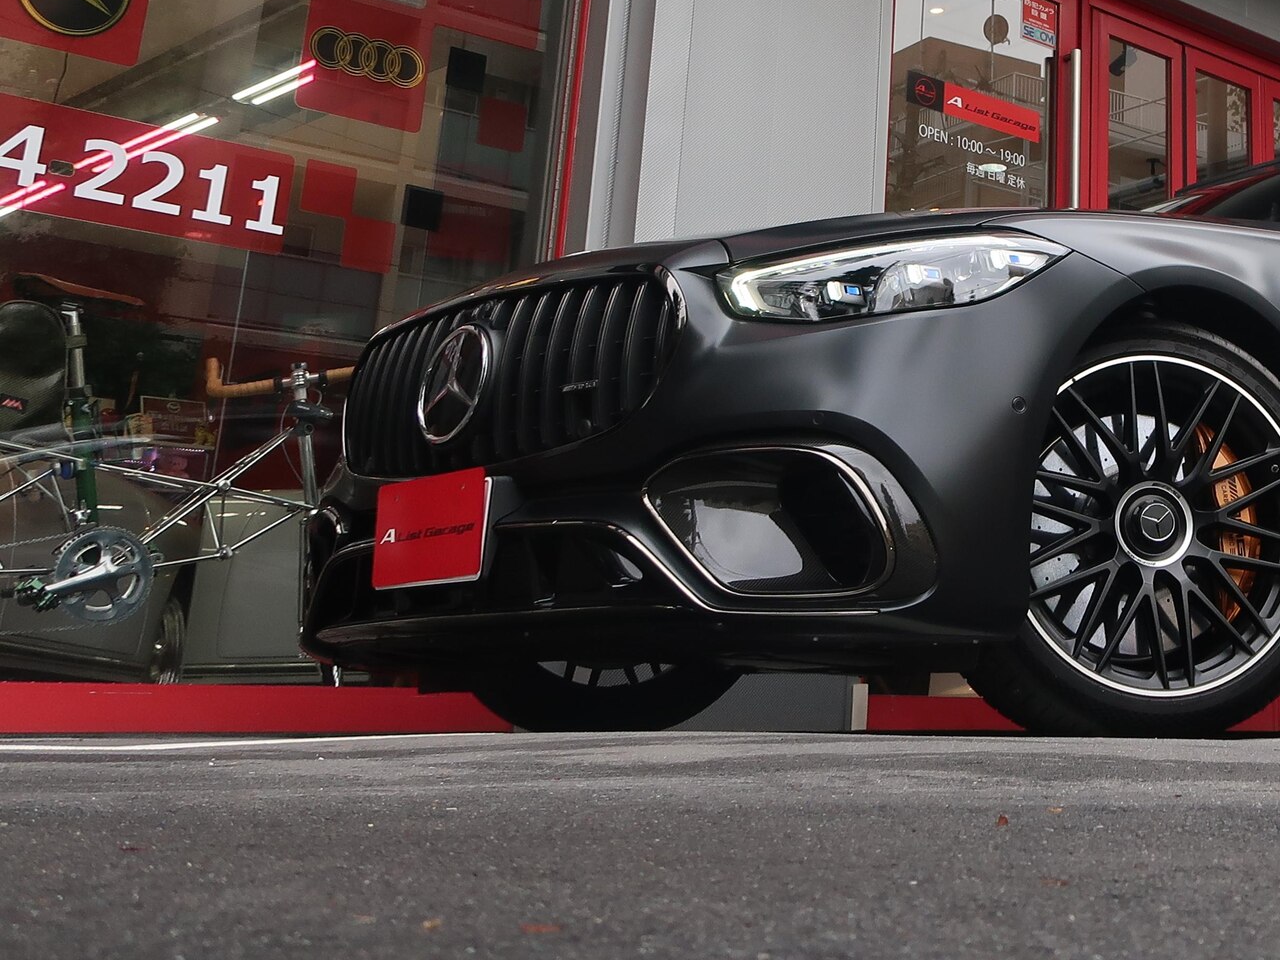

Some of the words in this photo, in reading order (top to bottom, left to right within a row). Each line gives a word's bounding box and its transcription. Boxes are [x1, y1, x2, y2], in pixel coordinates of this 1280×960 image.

[1023, 25, 1055, 45] SECOM
[946, 96, 963, 108] A
[964, 103, 989, 117] List
[990, 112, 1037, 132] Garage
[919, 124, 949, 144] OPEN
[956, 135, 984, 155] 10:00
[999, 148, 1026, 167] 19:00
[380, 528, 396, 545] A
[424, 522, 475, 539] Garage
